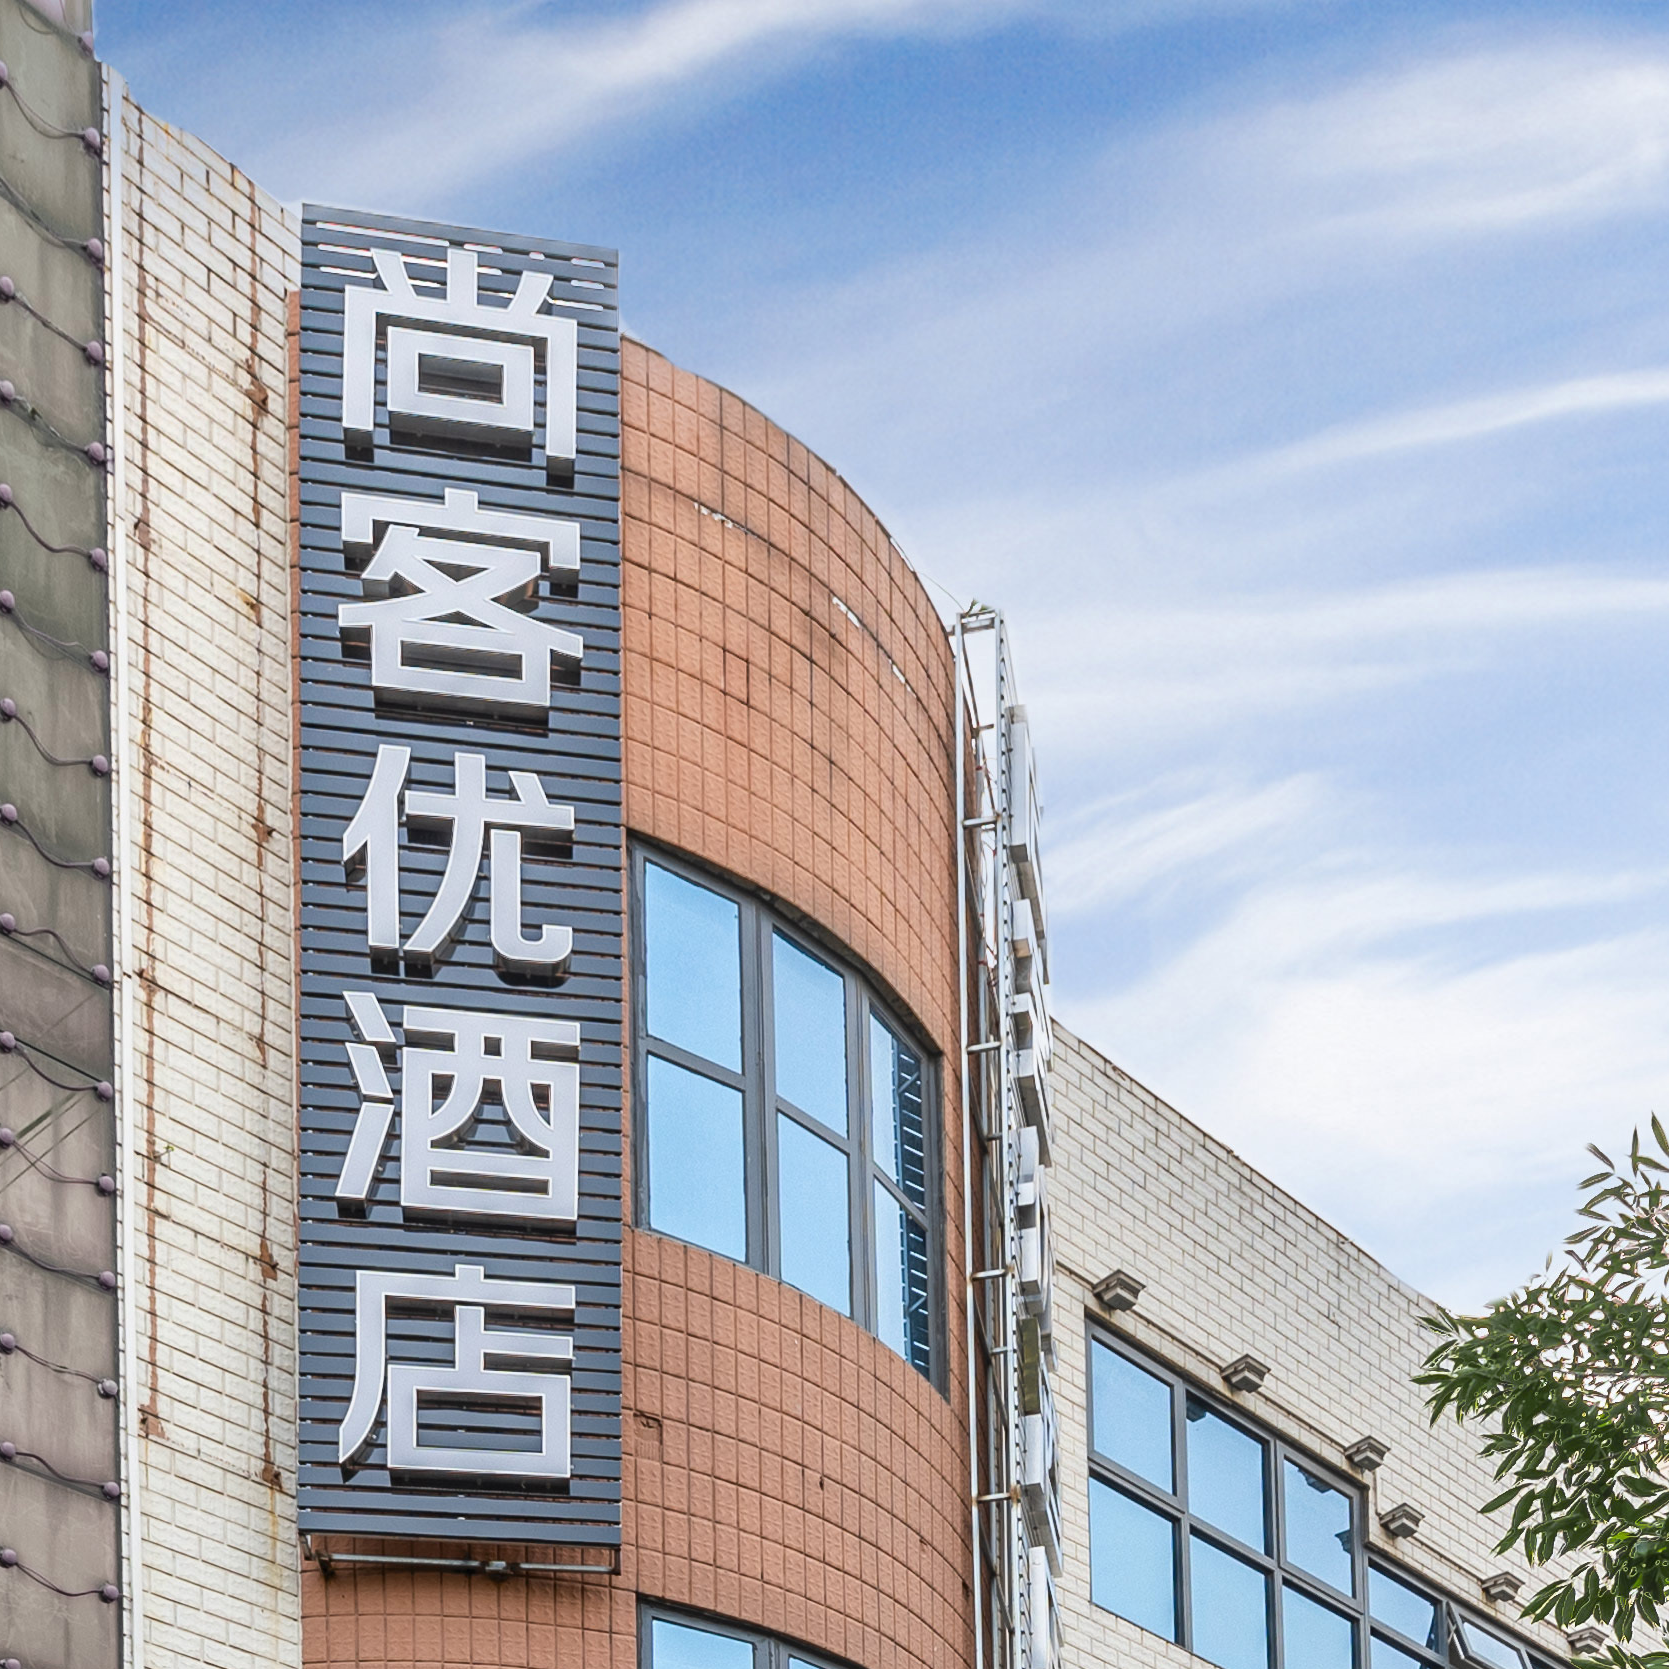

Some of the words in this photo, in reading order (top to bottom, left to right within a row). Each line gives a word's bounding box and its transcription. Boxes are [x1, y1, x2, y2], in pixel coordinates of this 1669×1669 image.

[337, 247, 583, 1484] 尚客优酒店
